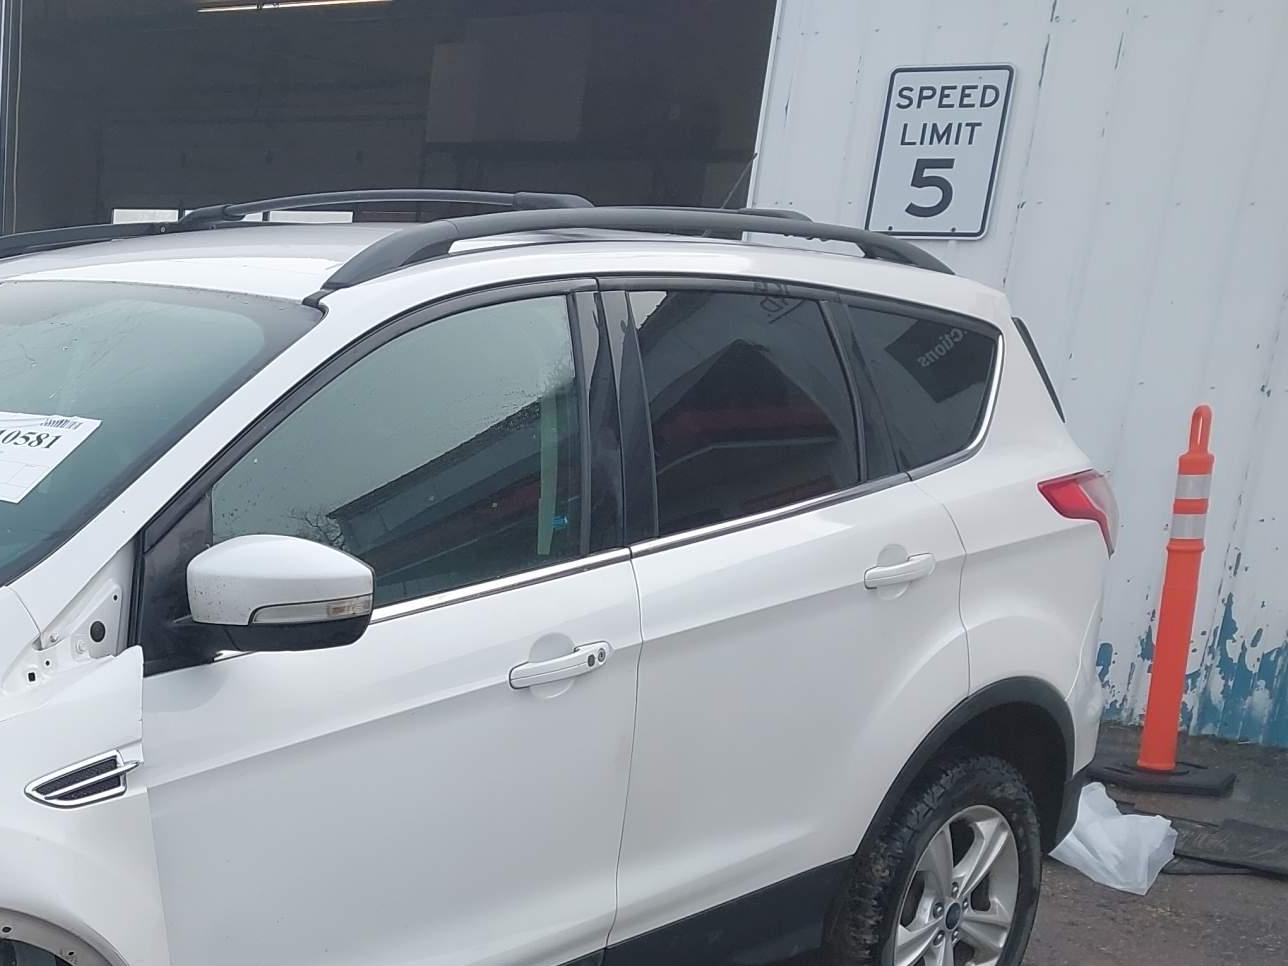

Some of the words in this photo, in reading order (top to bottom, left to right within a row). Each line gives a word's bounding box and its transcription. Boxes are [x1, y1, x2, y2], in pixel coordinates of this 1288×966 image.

[896, 85, 1000, 109] SPEED
[900, 122, 982, 145] LIMIT
[905, 158, 955, 217] 5
